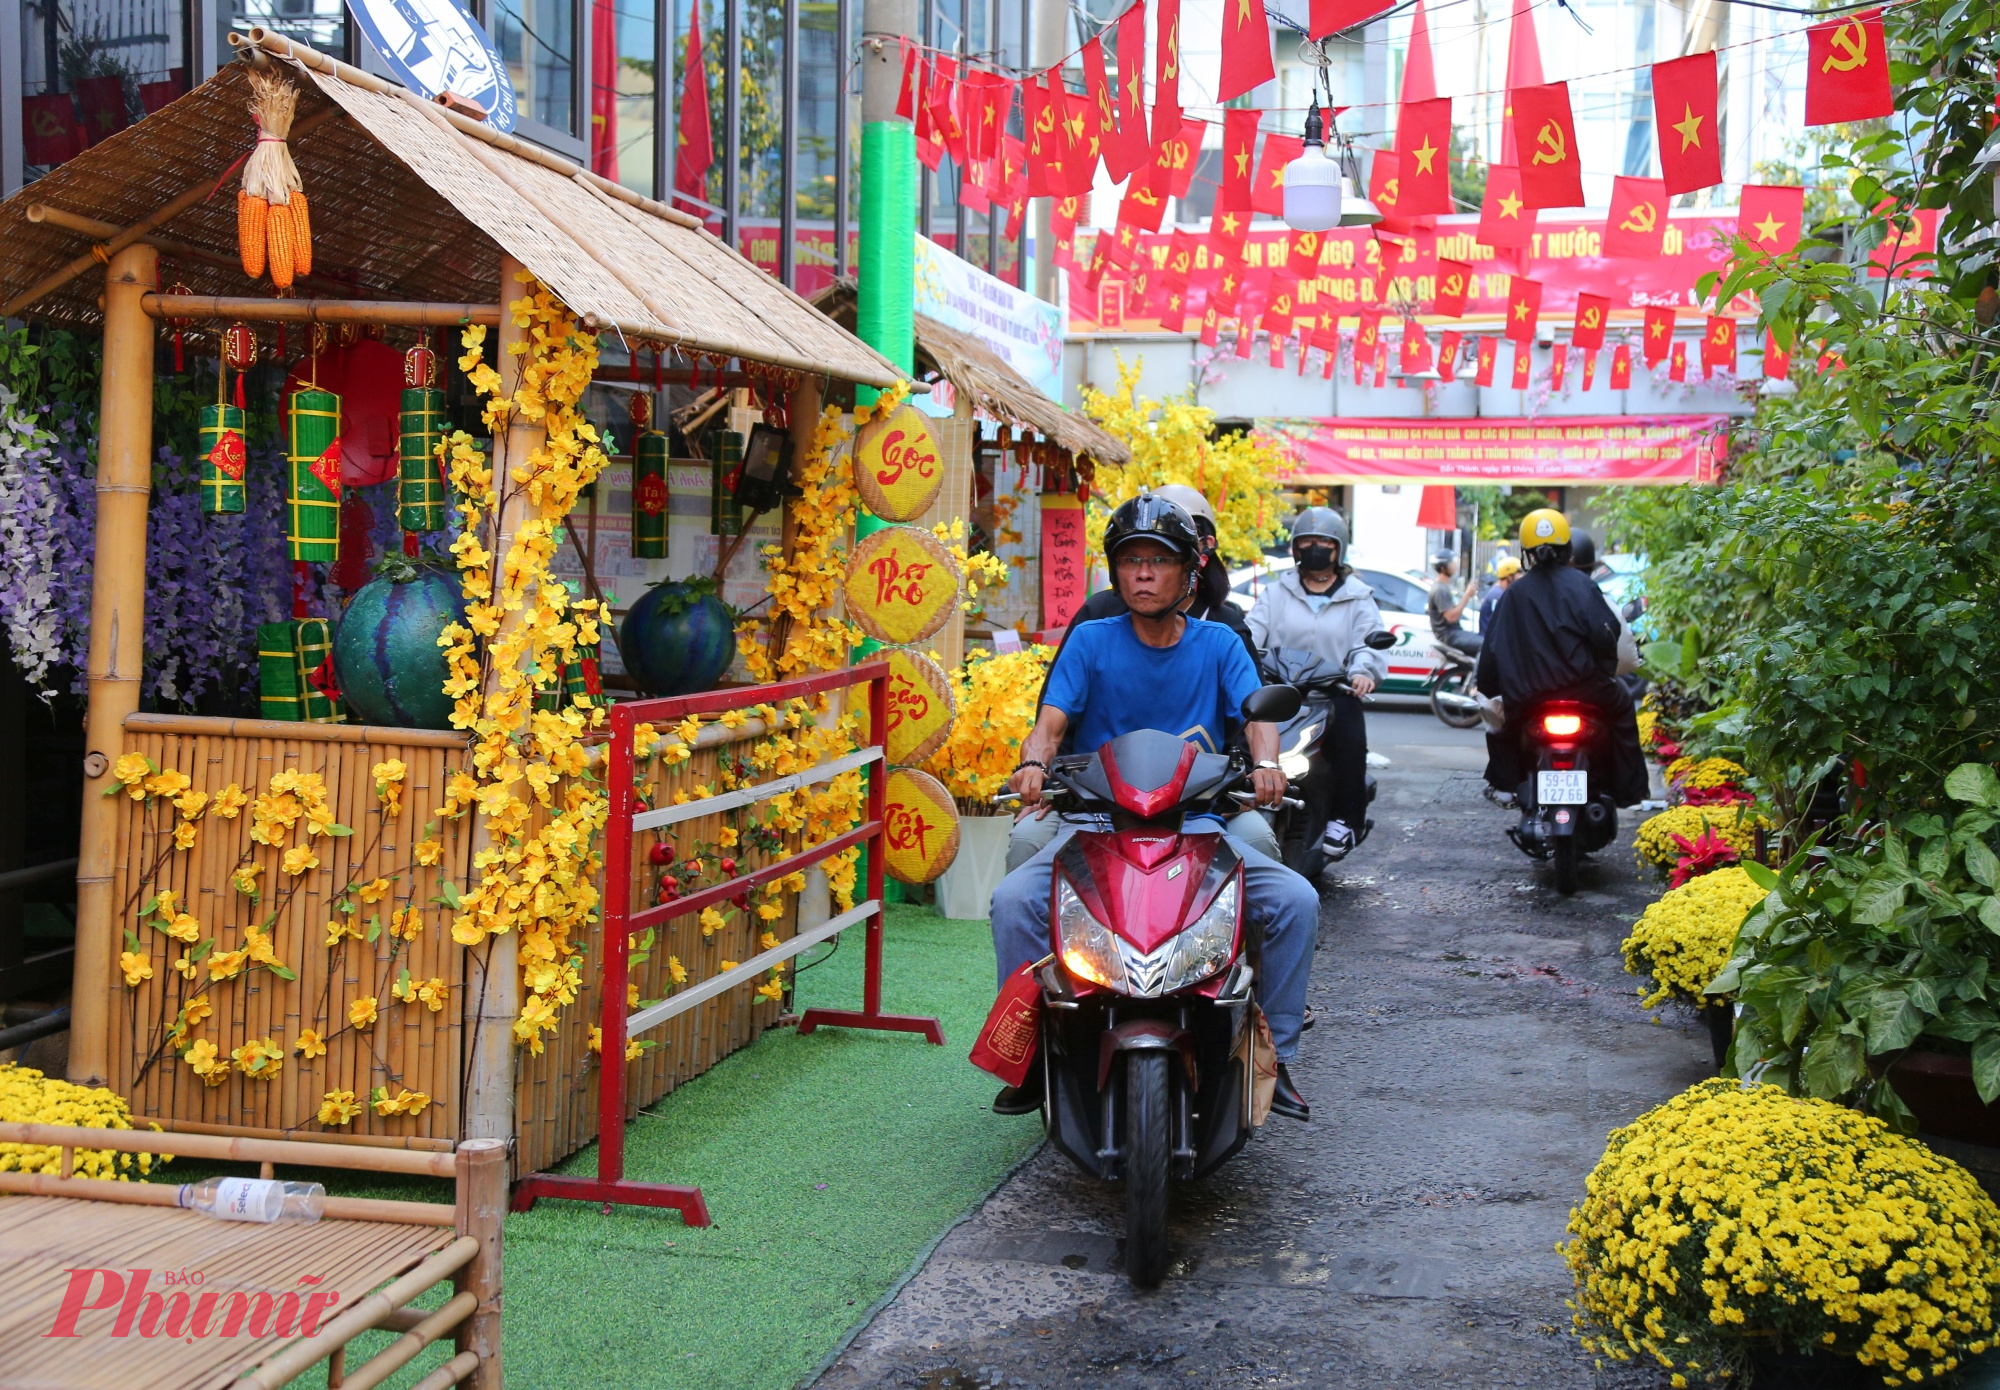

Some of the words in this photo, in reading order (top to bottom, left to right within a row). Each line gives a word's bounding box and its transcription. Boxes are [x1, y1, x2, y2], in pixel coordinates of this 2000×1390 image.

[486, 48, 511, 90] MINH
[1547, 225, 1601, 259] NƯỚC
[876, 429, 936, 486] Góc
[868, 548, 933, 607] Phố
[1543, 788, 1583, 801] 127.66
[1545, 774, 1579, 787] 59-CA
[885, 803, 935, 861] Tết
